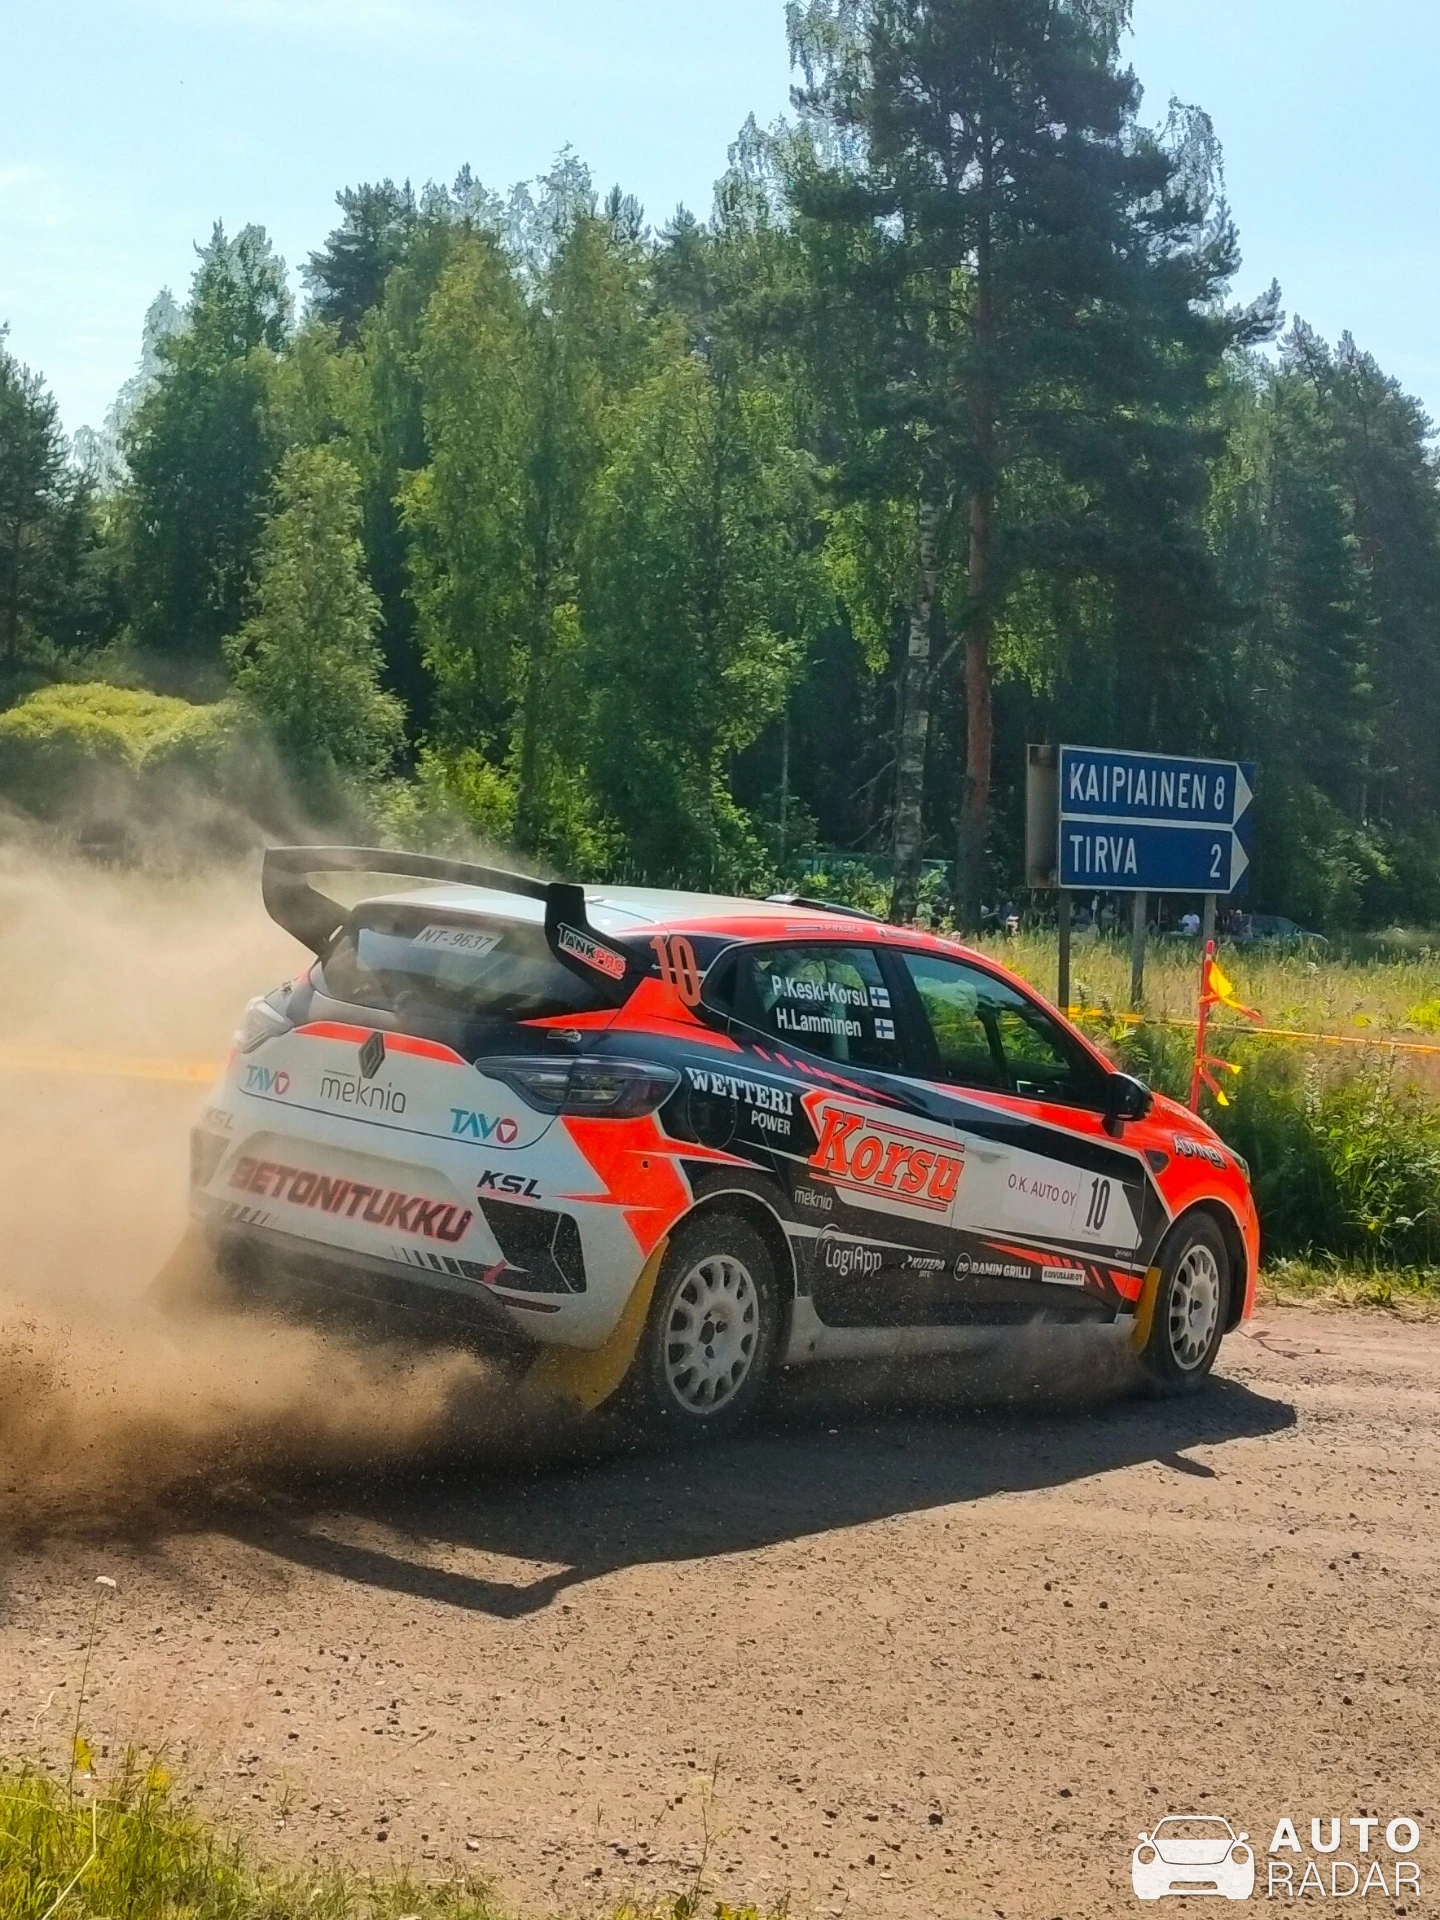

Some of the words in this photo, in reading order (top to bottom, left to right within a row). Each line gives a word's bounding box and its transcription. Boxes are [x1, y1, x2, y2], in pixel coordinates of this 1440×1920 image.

[1069, 762, 1207, 811] KAIPIAINEN
[1213, 775, 1226, 811] 8
[1069, 834, 1138, 875] TIRVA
[1209, 843, 1222, 878] 2
[417, 928, 495, 951] NT-9637
[650, 935, 701, 1007] 10
[771, 974, 869, 1007] P.Keski-Korsu
[776, 1007, 862, 1038] H.Lamminen
[319, 1075, 407, 1114] meknio
[685, 1066, 794, 1116] WETTERI
[751, 1110, 791, 1135] POWER
[807, 1106, 964, 1202] Korsu
[228, 1156, 474, 1243] BETONITUKKU
[476, 1169, 542, 1200] KSL
[794, 1188, 833, 1211] meknio
[1007, 1173, 1027, 1193] O.K.
[1031, 1181, 1060, 1202] AUTO
[1061, 1188, 1078, 1207] OY
[1085, 1177, 1111, 1231] 10
[825, 1245, 883, 1277] LogiApp
[970, 1261, 1003, 1276] RAMIN
[1003, 1264, 1032, 1280] GRILLI
